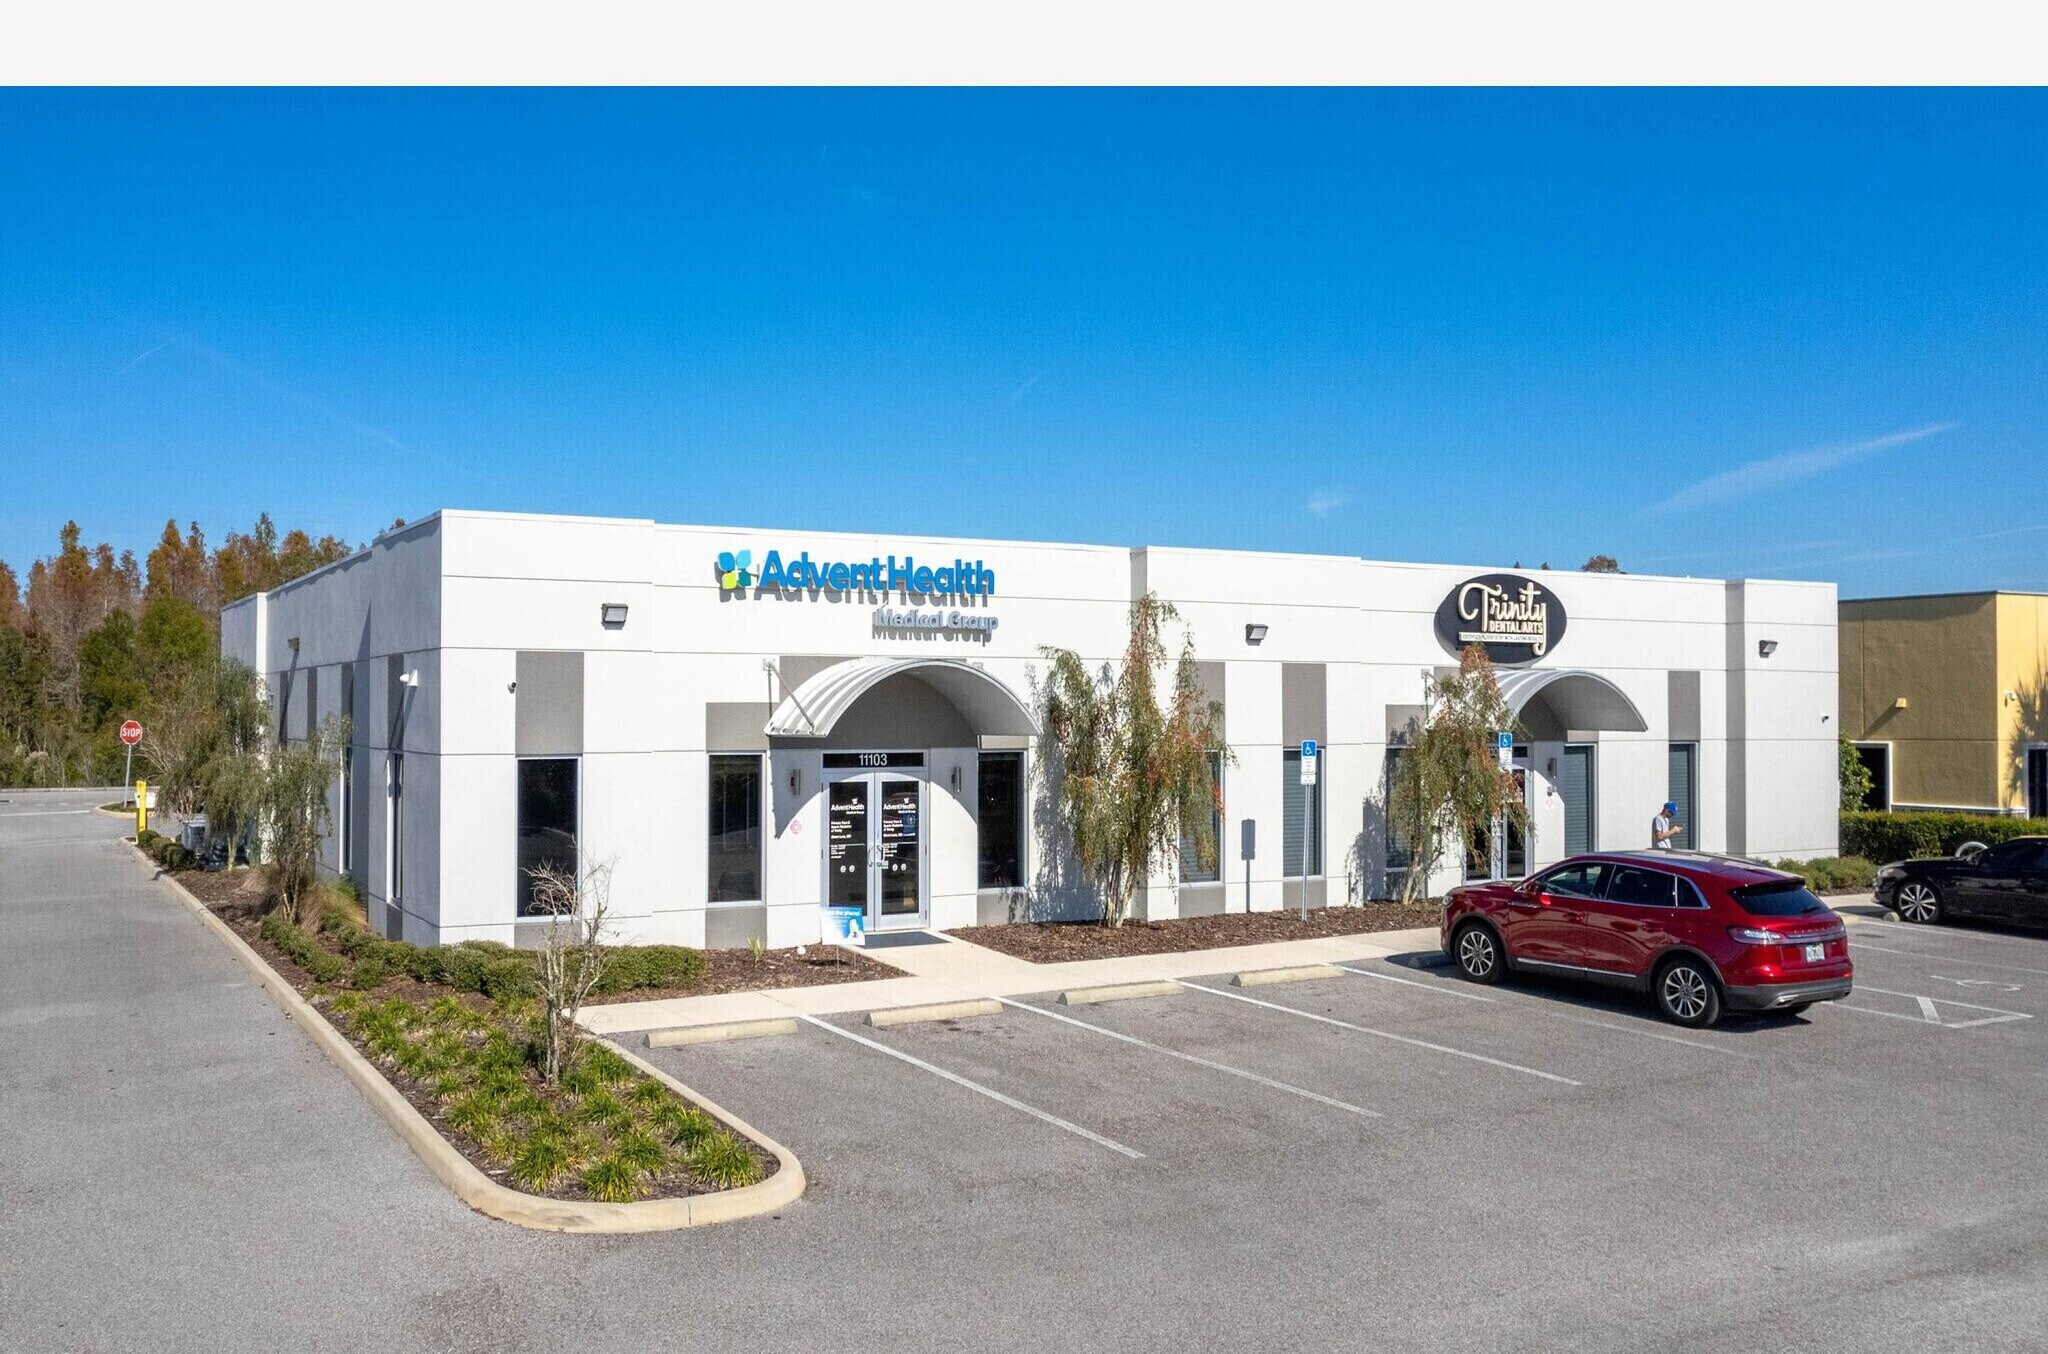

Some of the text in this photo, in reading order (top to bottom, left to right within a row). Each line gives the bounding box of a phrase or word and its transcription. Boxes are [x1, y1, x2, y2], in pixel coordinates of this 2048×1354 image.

[758, 550, 995, 594] AdventHealth
[875, 608, 999, 631] Medical Group
[1458, 581, 1547, 656] Trinity
[1489, 620, 1543, 634] DENTAL ARTS
[122, 727, 141, 737] STOP
[859, 753, 887, 766] 11103
